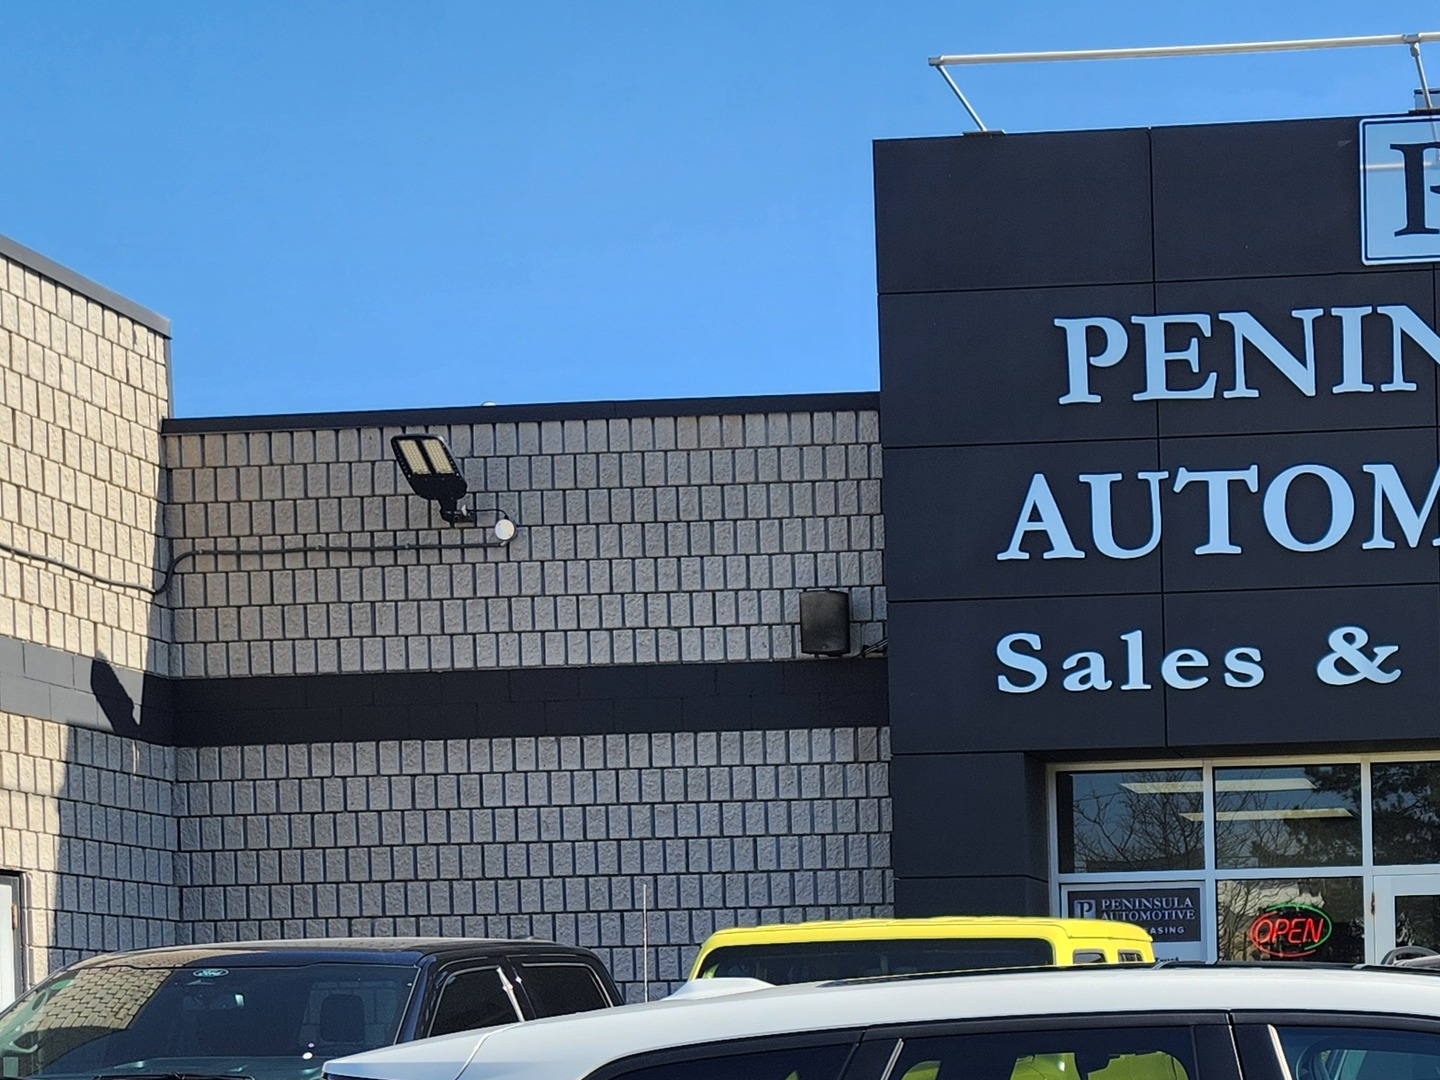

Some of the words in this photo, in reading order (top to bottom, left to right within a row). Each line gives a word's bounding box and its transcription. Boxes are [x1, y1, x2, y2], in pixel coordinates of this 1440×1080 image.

[997, 630, 1264, 692] Sales
[1317, 627, 1401, 685] &
[1101, 897, 1194, 911] PENINSULA
[1101, 909, 1195, 921] AUTOMOTIVE
[1147, 926, 1185, 935] ASING
[1255, 918, 1324, 944] OPEN
